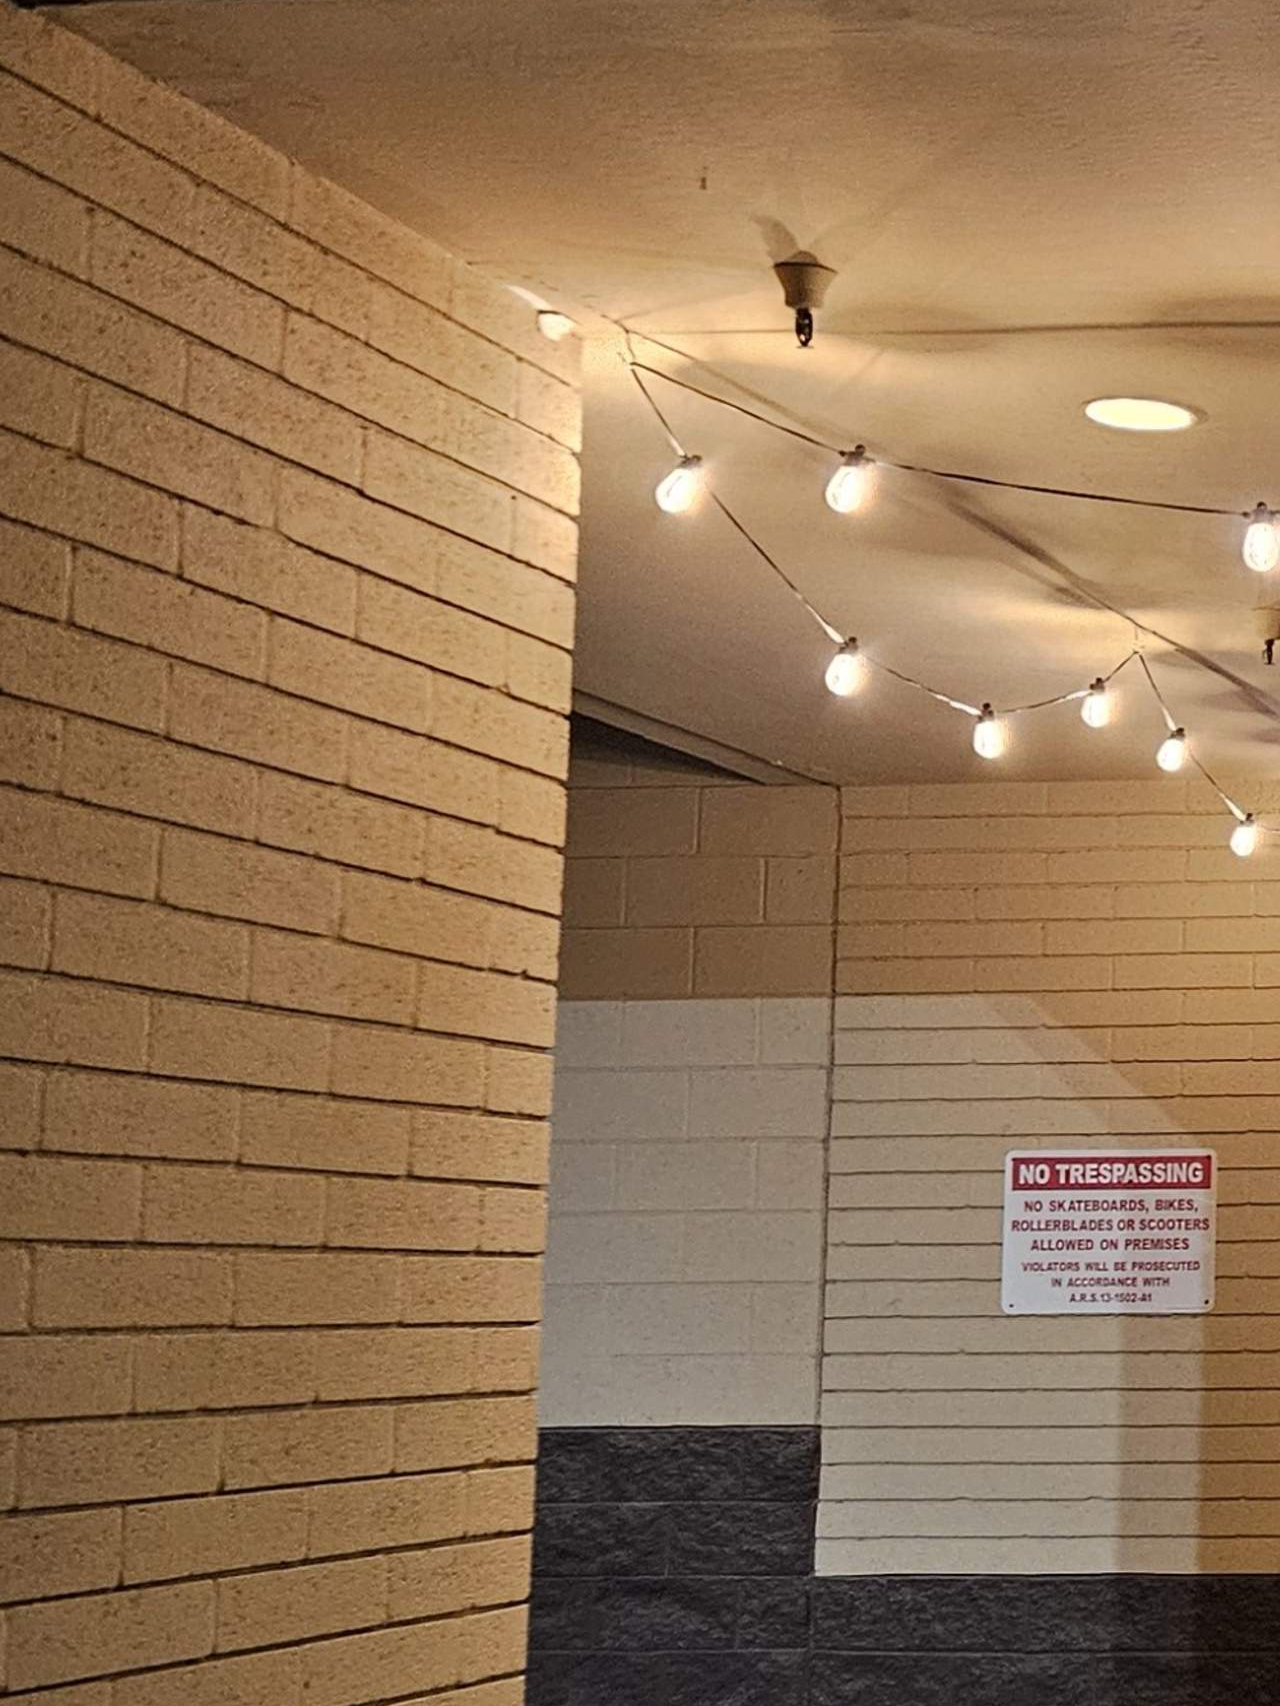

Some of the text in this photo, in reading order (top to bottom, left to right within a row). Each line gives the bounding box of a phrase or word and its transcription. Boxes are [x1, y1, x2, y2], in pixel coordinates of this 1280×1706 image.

[1019, 1162, 1204, 1185] NO TRESPASSING
[1024, 1198, 1199, 1213] NO SKATEBOARDS, BIKES,
[1012, 1218, 1210, 1232] ROLLERBLADES OR SCOOTERS
[1030, 1238, 1190, 1251] ALLOWED ON PREMISES
[1021, 1261, 1200, 1272] VIOLATORS WILL BE PROSECUTED
[1051, 1277, 1170, 1287] IN ACCORDANCE WITH
